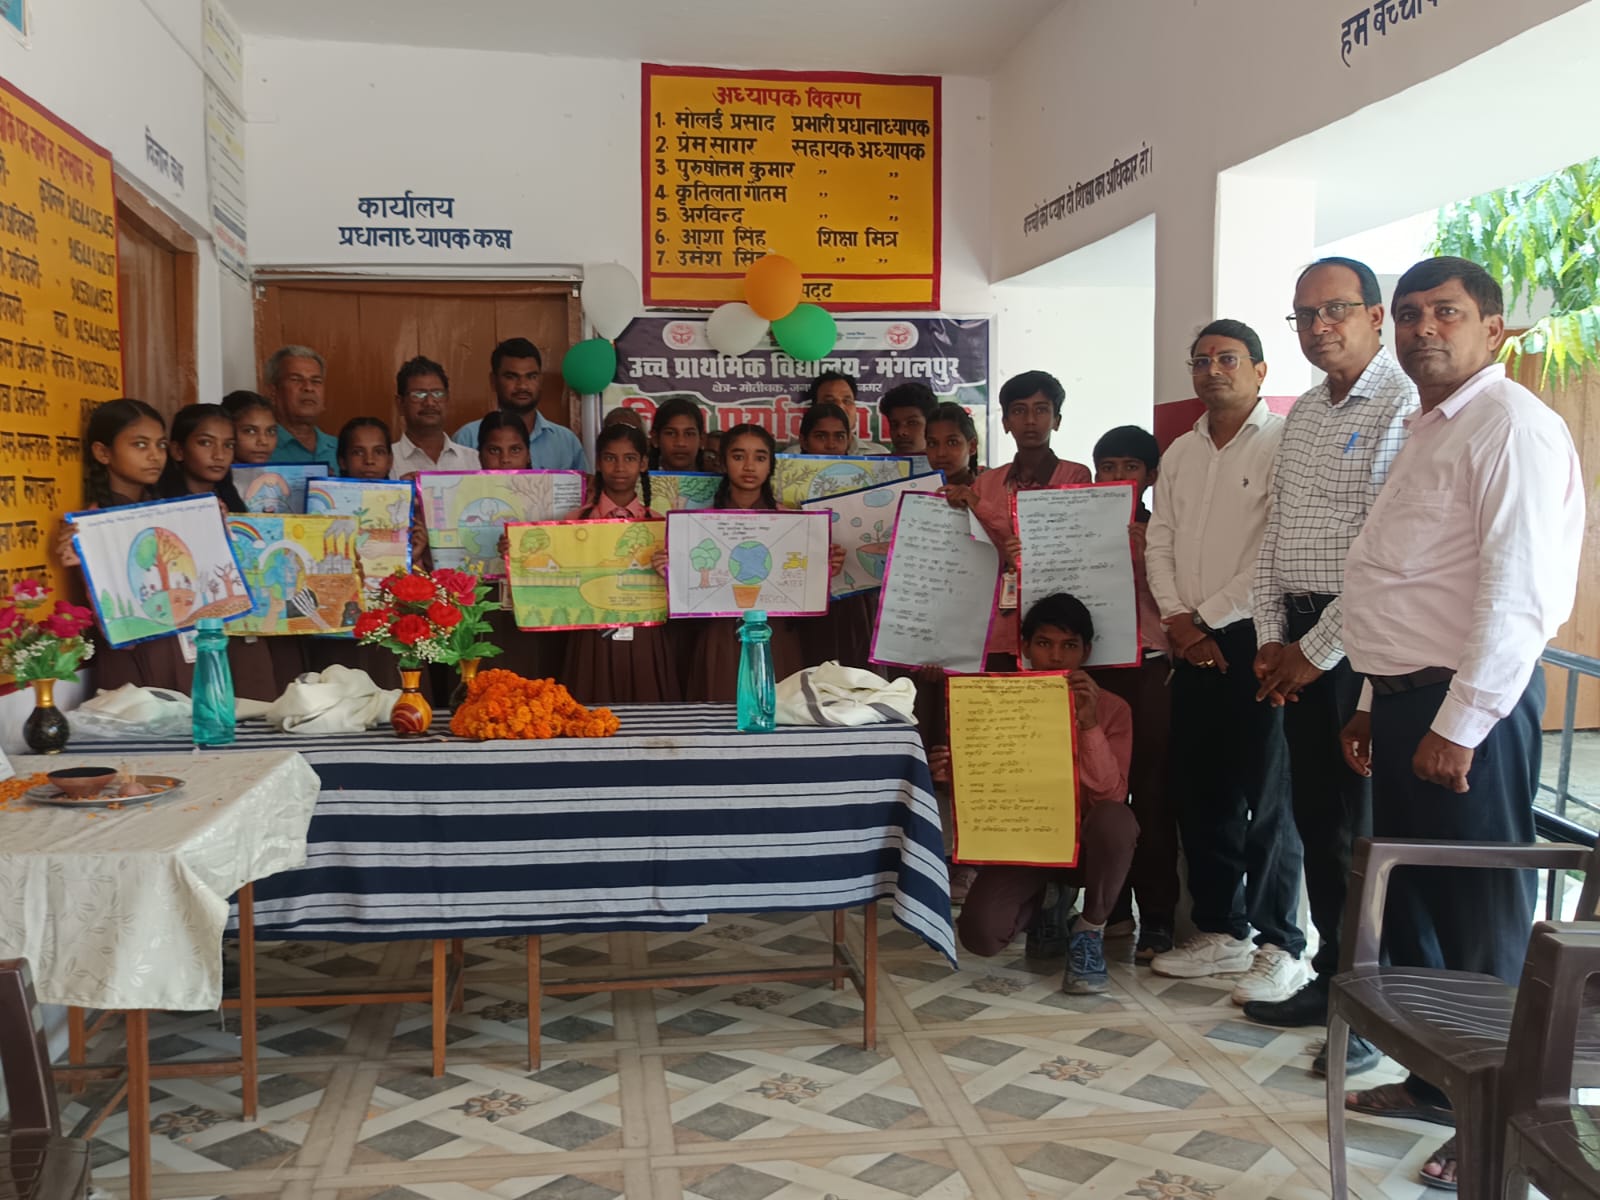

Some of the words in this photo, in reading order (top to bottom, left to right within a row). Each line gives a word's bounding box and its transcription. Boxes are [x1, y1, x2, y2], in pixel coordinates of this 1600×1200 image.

[1341, 7, 1370, 68] हम
[713, 86, 801, 107] अध्यापक
[805, 87, 861, 109] विवरण
[730, 113, 776, 132] प्रसाद
[792, 113, 835, 135] प्रभारी
[837, 117, 930, 137] प्रधानाध्यापक
[792, 139, 855, 158] सहायक
[858, 141, 926, 160] अध्यापक
[750, 161, 796, 182] कुमार
[358, 190, 455, 218] कार्यालय
[679, 204, 744, 224] अरविन्द
[680, 228, 724, 247] आशा
[733, 226, 767, 248] सिंह
[817, 227, 858, 248] शिक्षा
[865, 227, 898, 248] मित्र
[678, 246, 723, 266] उमेश
[627, 356, 670, 379] उच्च
[674, 353, 766, 379] प्राथमिक
[875, 351, 960, 385] मंगलपुर
